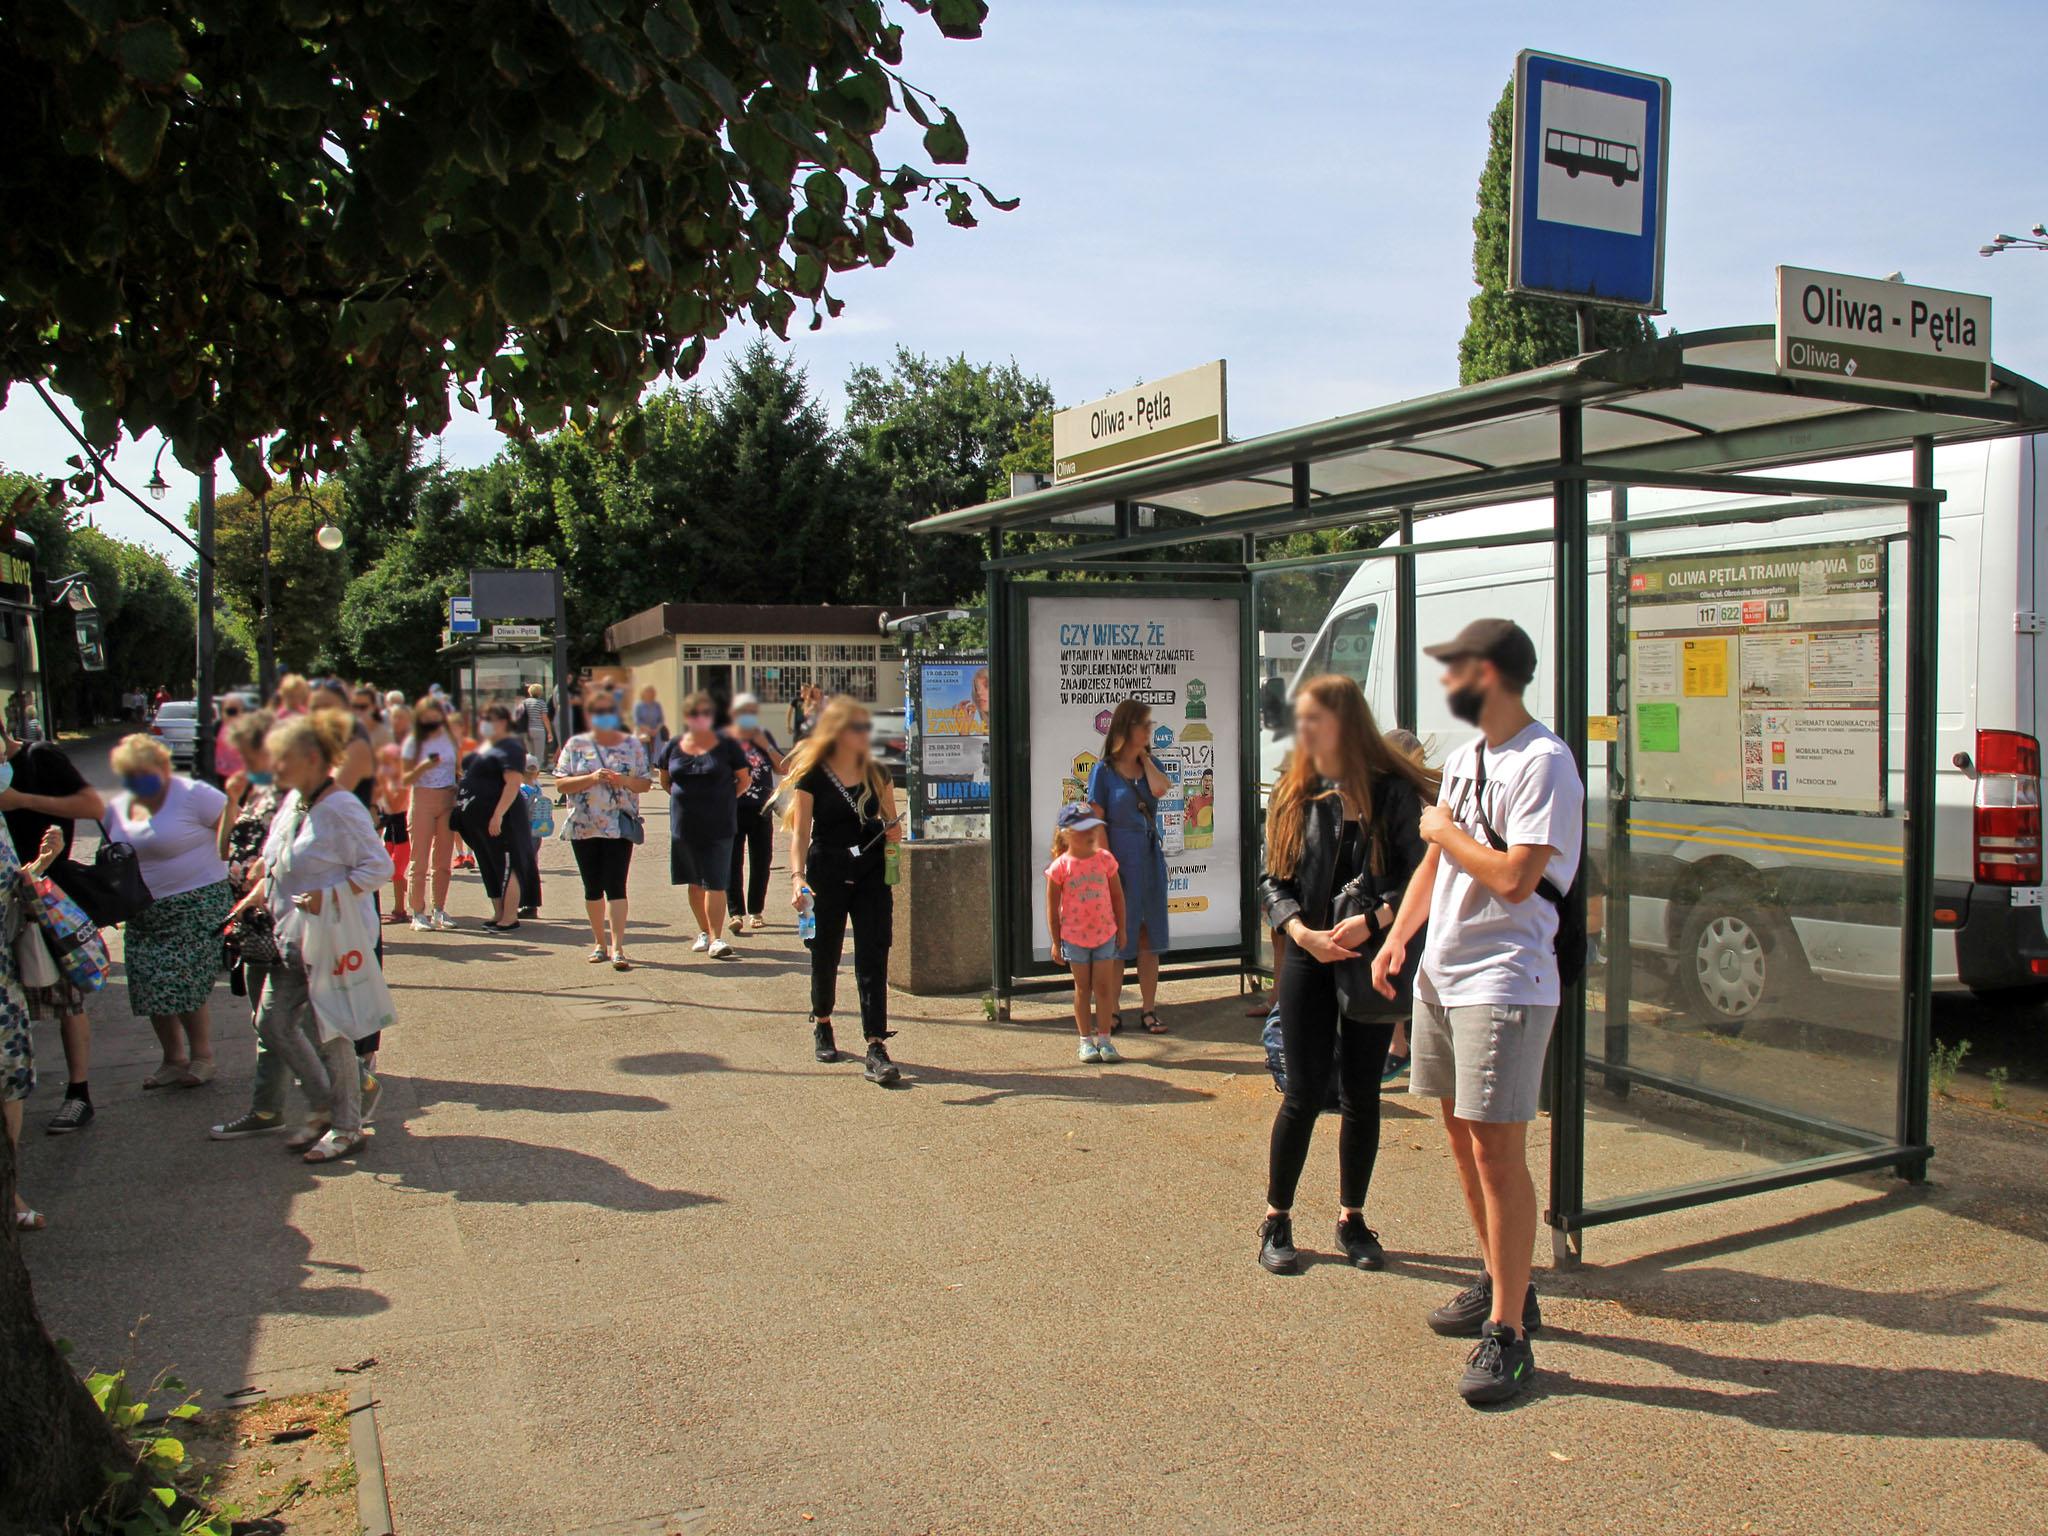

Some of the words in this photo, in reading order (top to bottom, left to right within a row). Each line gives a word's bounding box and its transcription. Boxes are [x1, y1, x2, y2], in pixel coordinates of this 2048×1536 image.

[1802, 284, 1883, 333] Oliwa
[1892, 316, 1901, 326] -
[1911, 300, 1977, 351] Pętla
[1790, 343, 1840, 369] Oliwa
[1090, 408, 1125, 439] Oliwa
[1136, 391, 1171, 429] Pętla
[1056, 461, 1076, 477] Oliwa
[1668, 571, 1707, 586] OLIWA
[1709, 566, 1747, 586] PĘTLA
[1749, 558, 1848, 580] TRAMWWA
[1859, 558, 1874, 570] 06
[1700, 608, 1716, 622] 117
[1721, 607, 1740, 620] 622
[1770, 603, 1785, 619] N4
[1059, 623, 1089, 646] CZY
[1093, 623, 1144, 648] WIESZ,
[1147, 620, 1166, 646] ŻE
[1060, 650, 1103, 661] WITAMINY
[1111, 650, 1154, 661] MINERAŁY
[1155, 650, 1195, 661] ZAWARTE
[1060, 664, 1069, 675] W
[1071, 664, 1138, 675] SUPLEMENTACH
[1140, 664, 1177, 675] WITAMIN
[1060, 678, 1111, 690] ZNAJDZIESZ
[1113, 676, 1152, 690] RÓWNIEŻ
[1060, 692, 1069, 704] W
[1071, 692, 1127, 704] PRODUKTACH
[1131, 692, 1174, 703] OSHEE
